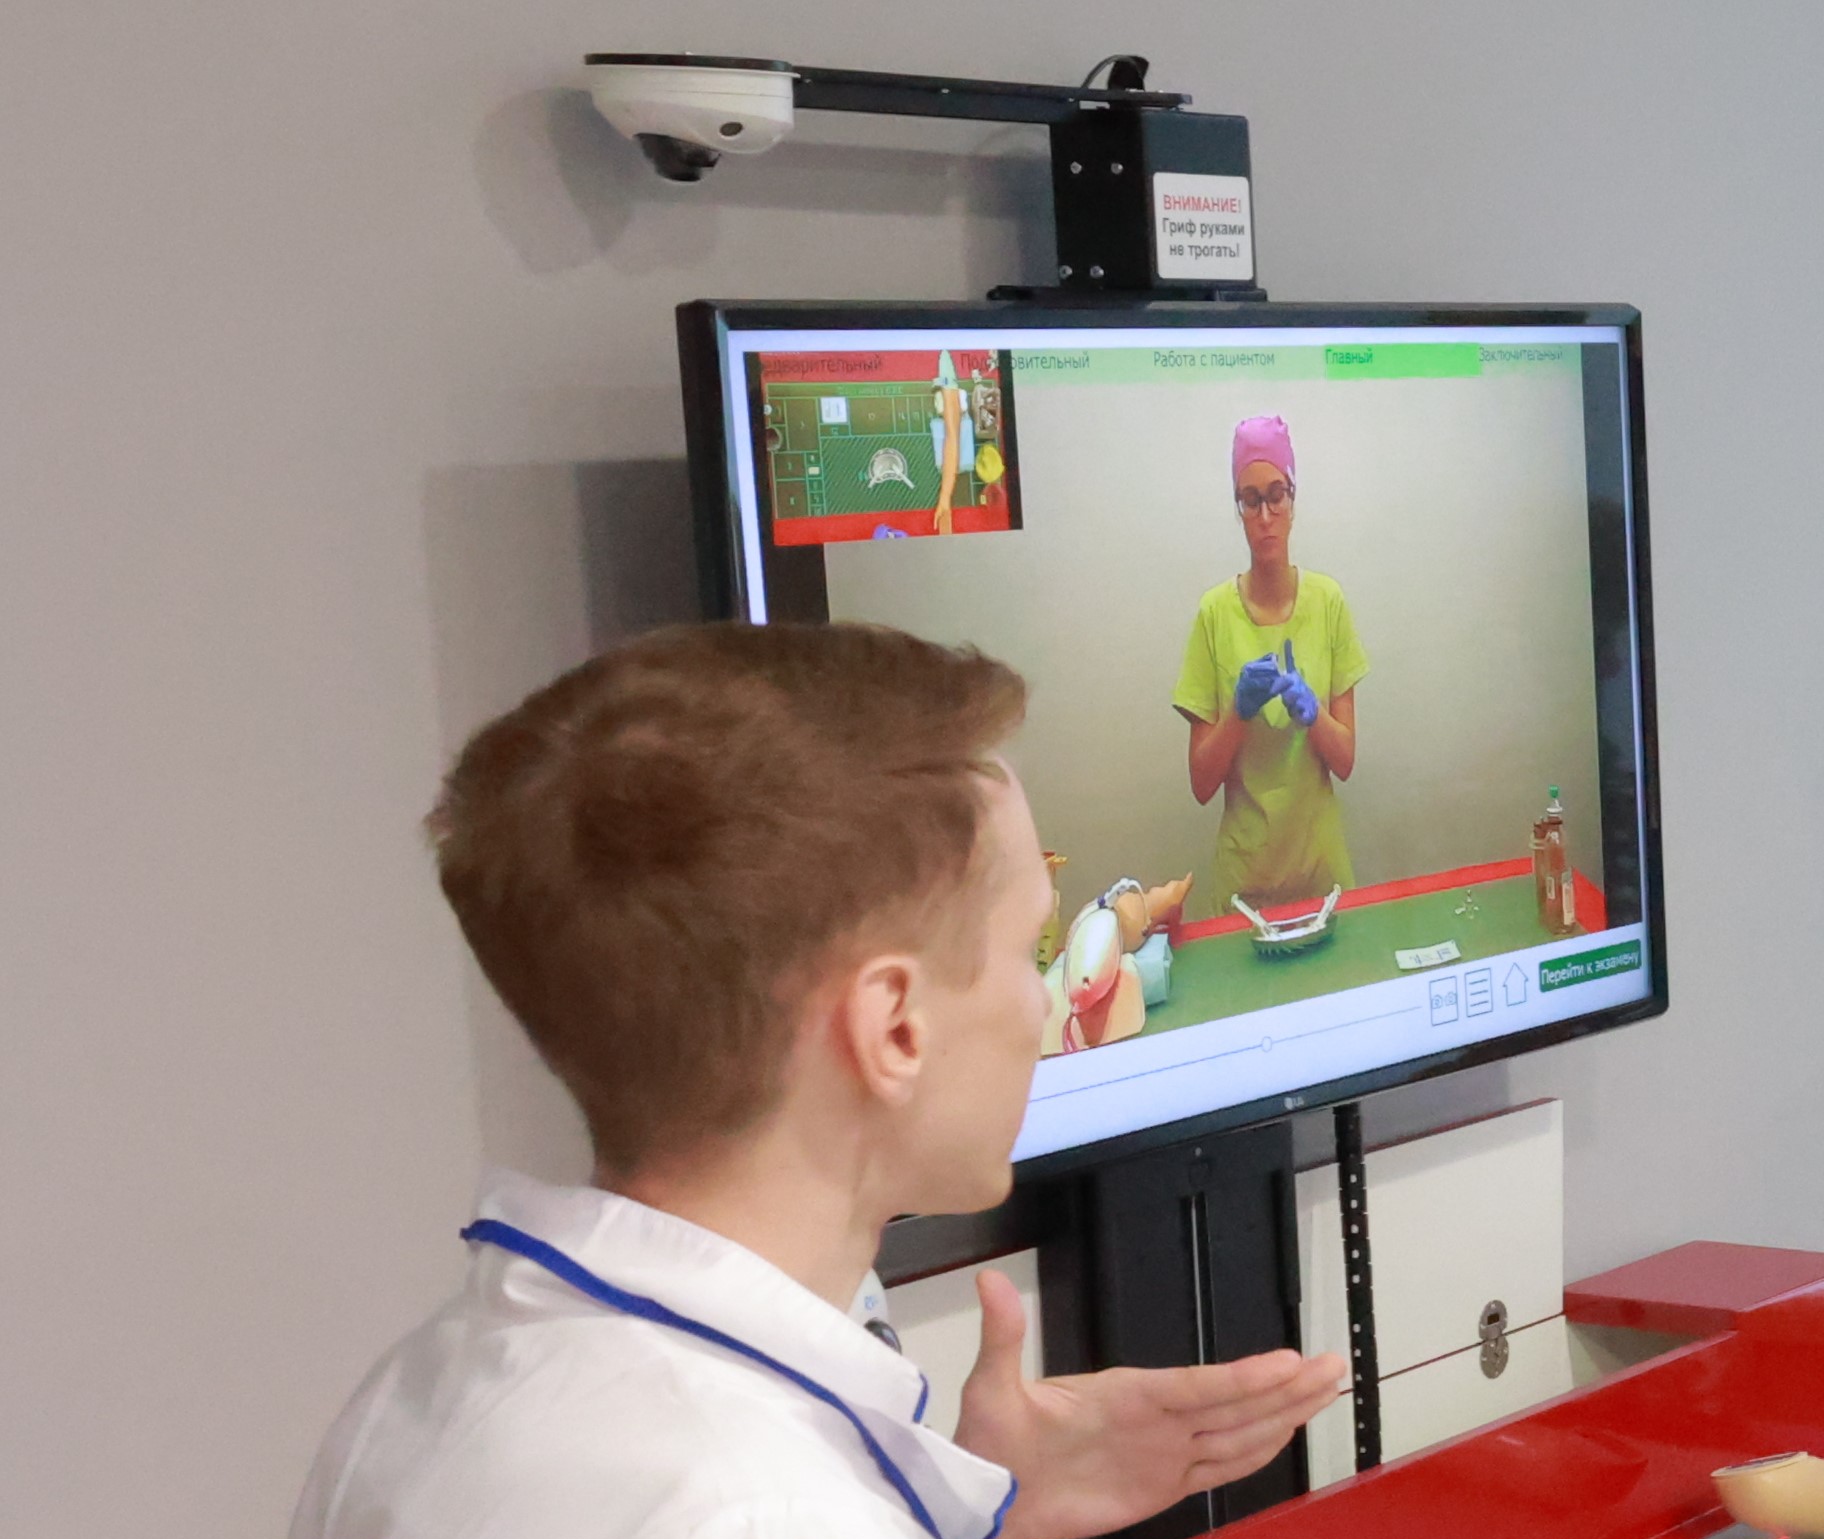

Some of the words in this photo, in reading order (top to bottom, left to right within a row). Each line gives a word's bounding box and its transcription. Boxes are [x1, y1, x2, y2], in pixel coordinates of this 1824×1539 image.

[1163, 194, 1242, 213] ВНИМАНИЕ!
[1162, 217, 1197, 237] Гриф
[1200, 222, 1245, 239] руками
[1169, 244, 1185, 256] не
[1188, 243, 1240, 260] трогать!
[1154, 350, 1196, 367] Работа
[1200, 354, 1207, 366] с
[1211, 353, 1275, 368] пациентом
[1326, 347, 1373, 364] Главный
[1479, 346, 1563, 361] Заключительный
[1541, 962, 1584, 985] Перейти
[1587, 963, 1593, 975] к
[1595, 951, 1639, 970] экзамену
